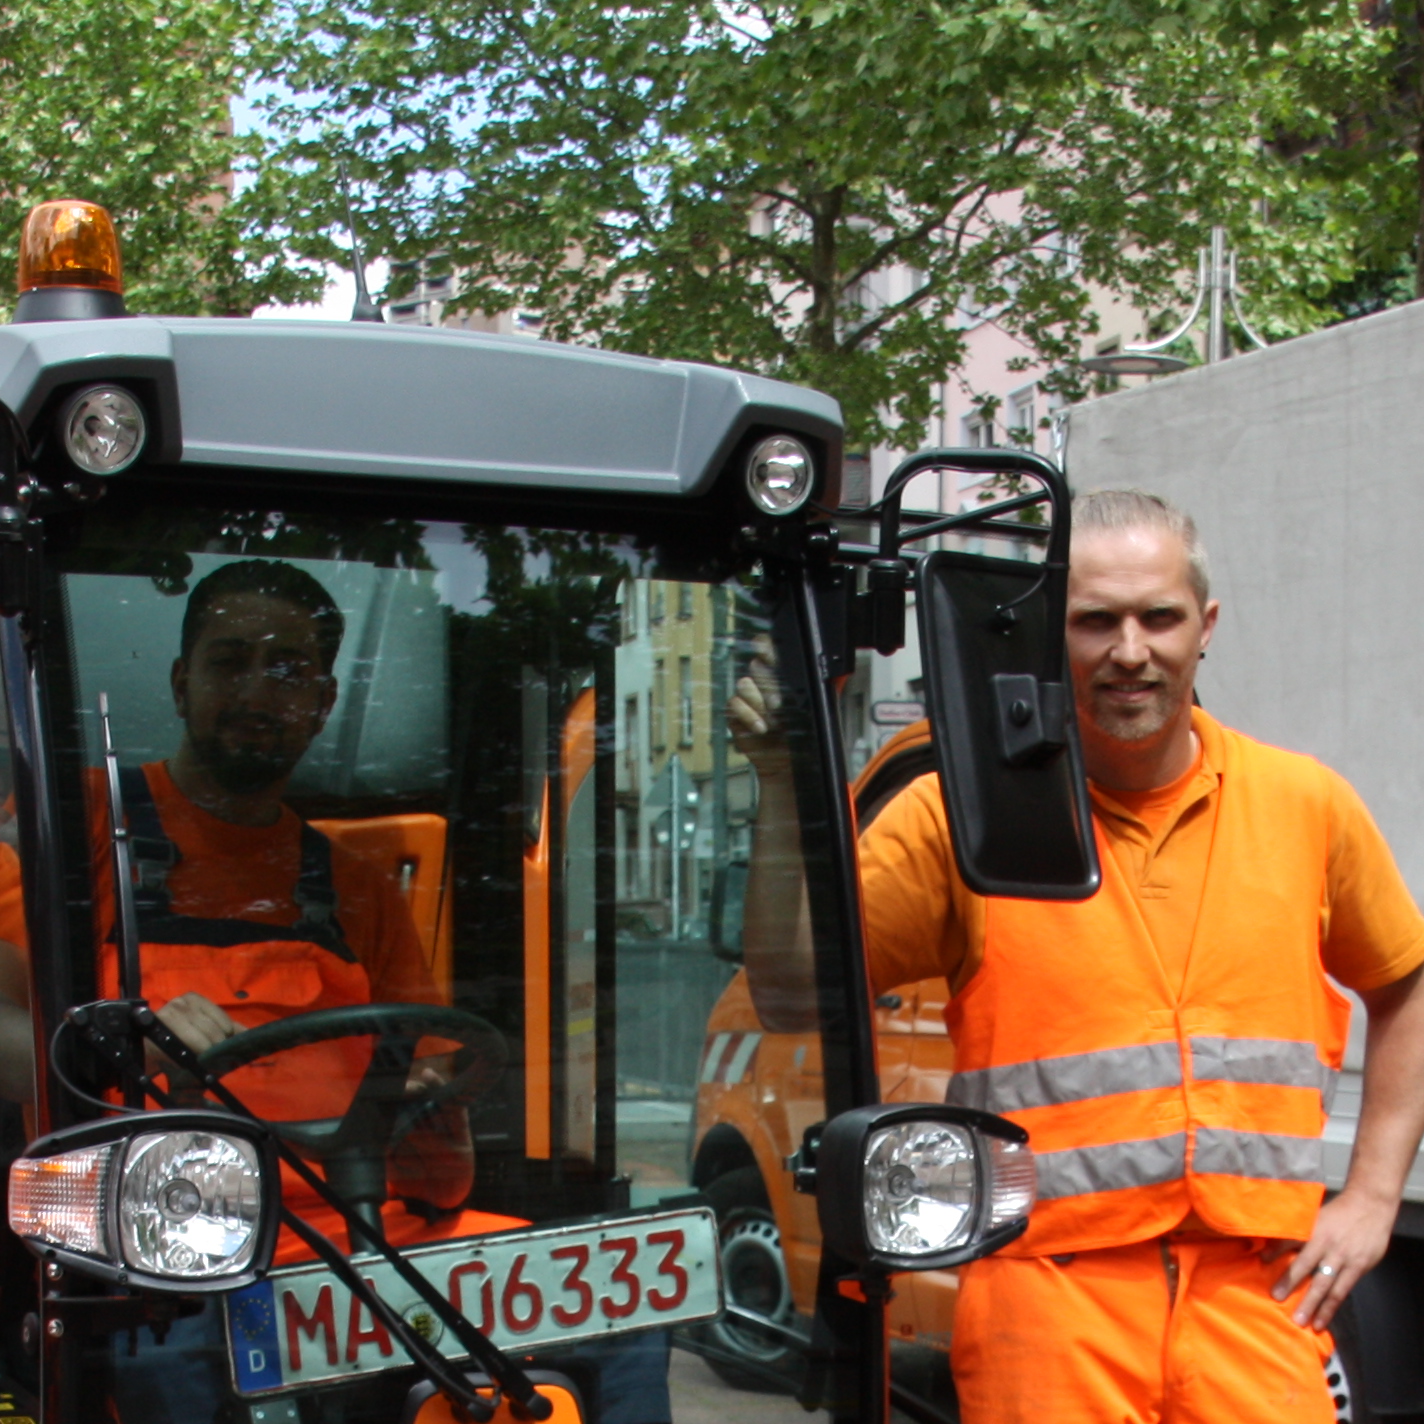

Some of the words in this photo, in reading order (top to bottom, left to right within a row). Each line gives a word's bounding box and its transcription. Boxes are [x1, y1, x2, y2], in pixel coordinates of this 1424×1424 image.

[282, 1276, 395, 1373] MA
[447, 1228, 689, 1341] 06333
[248, 1348, 266, 1374] D
